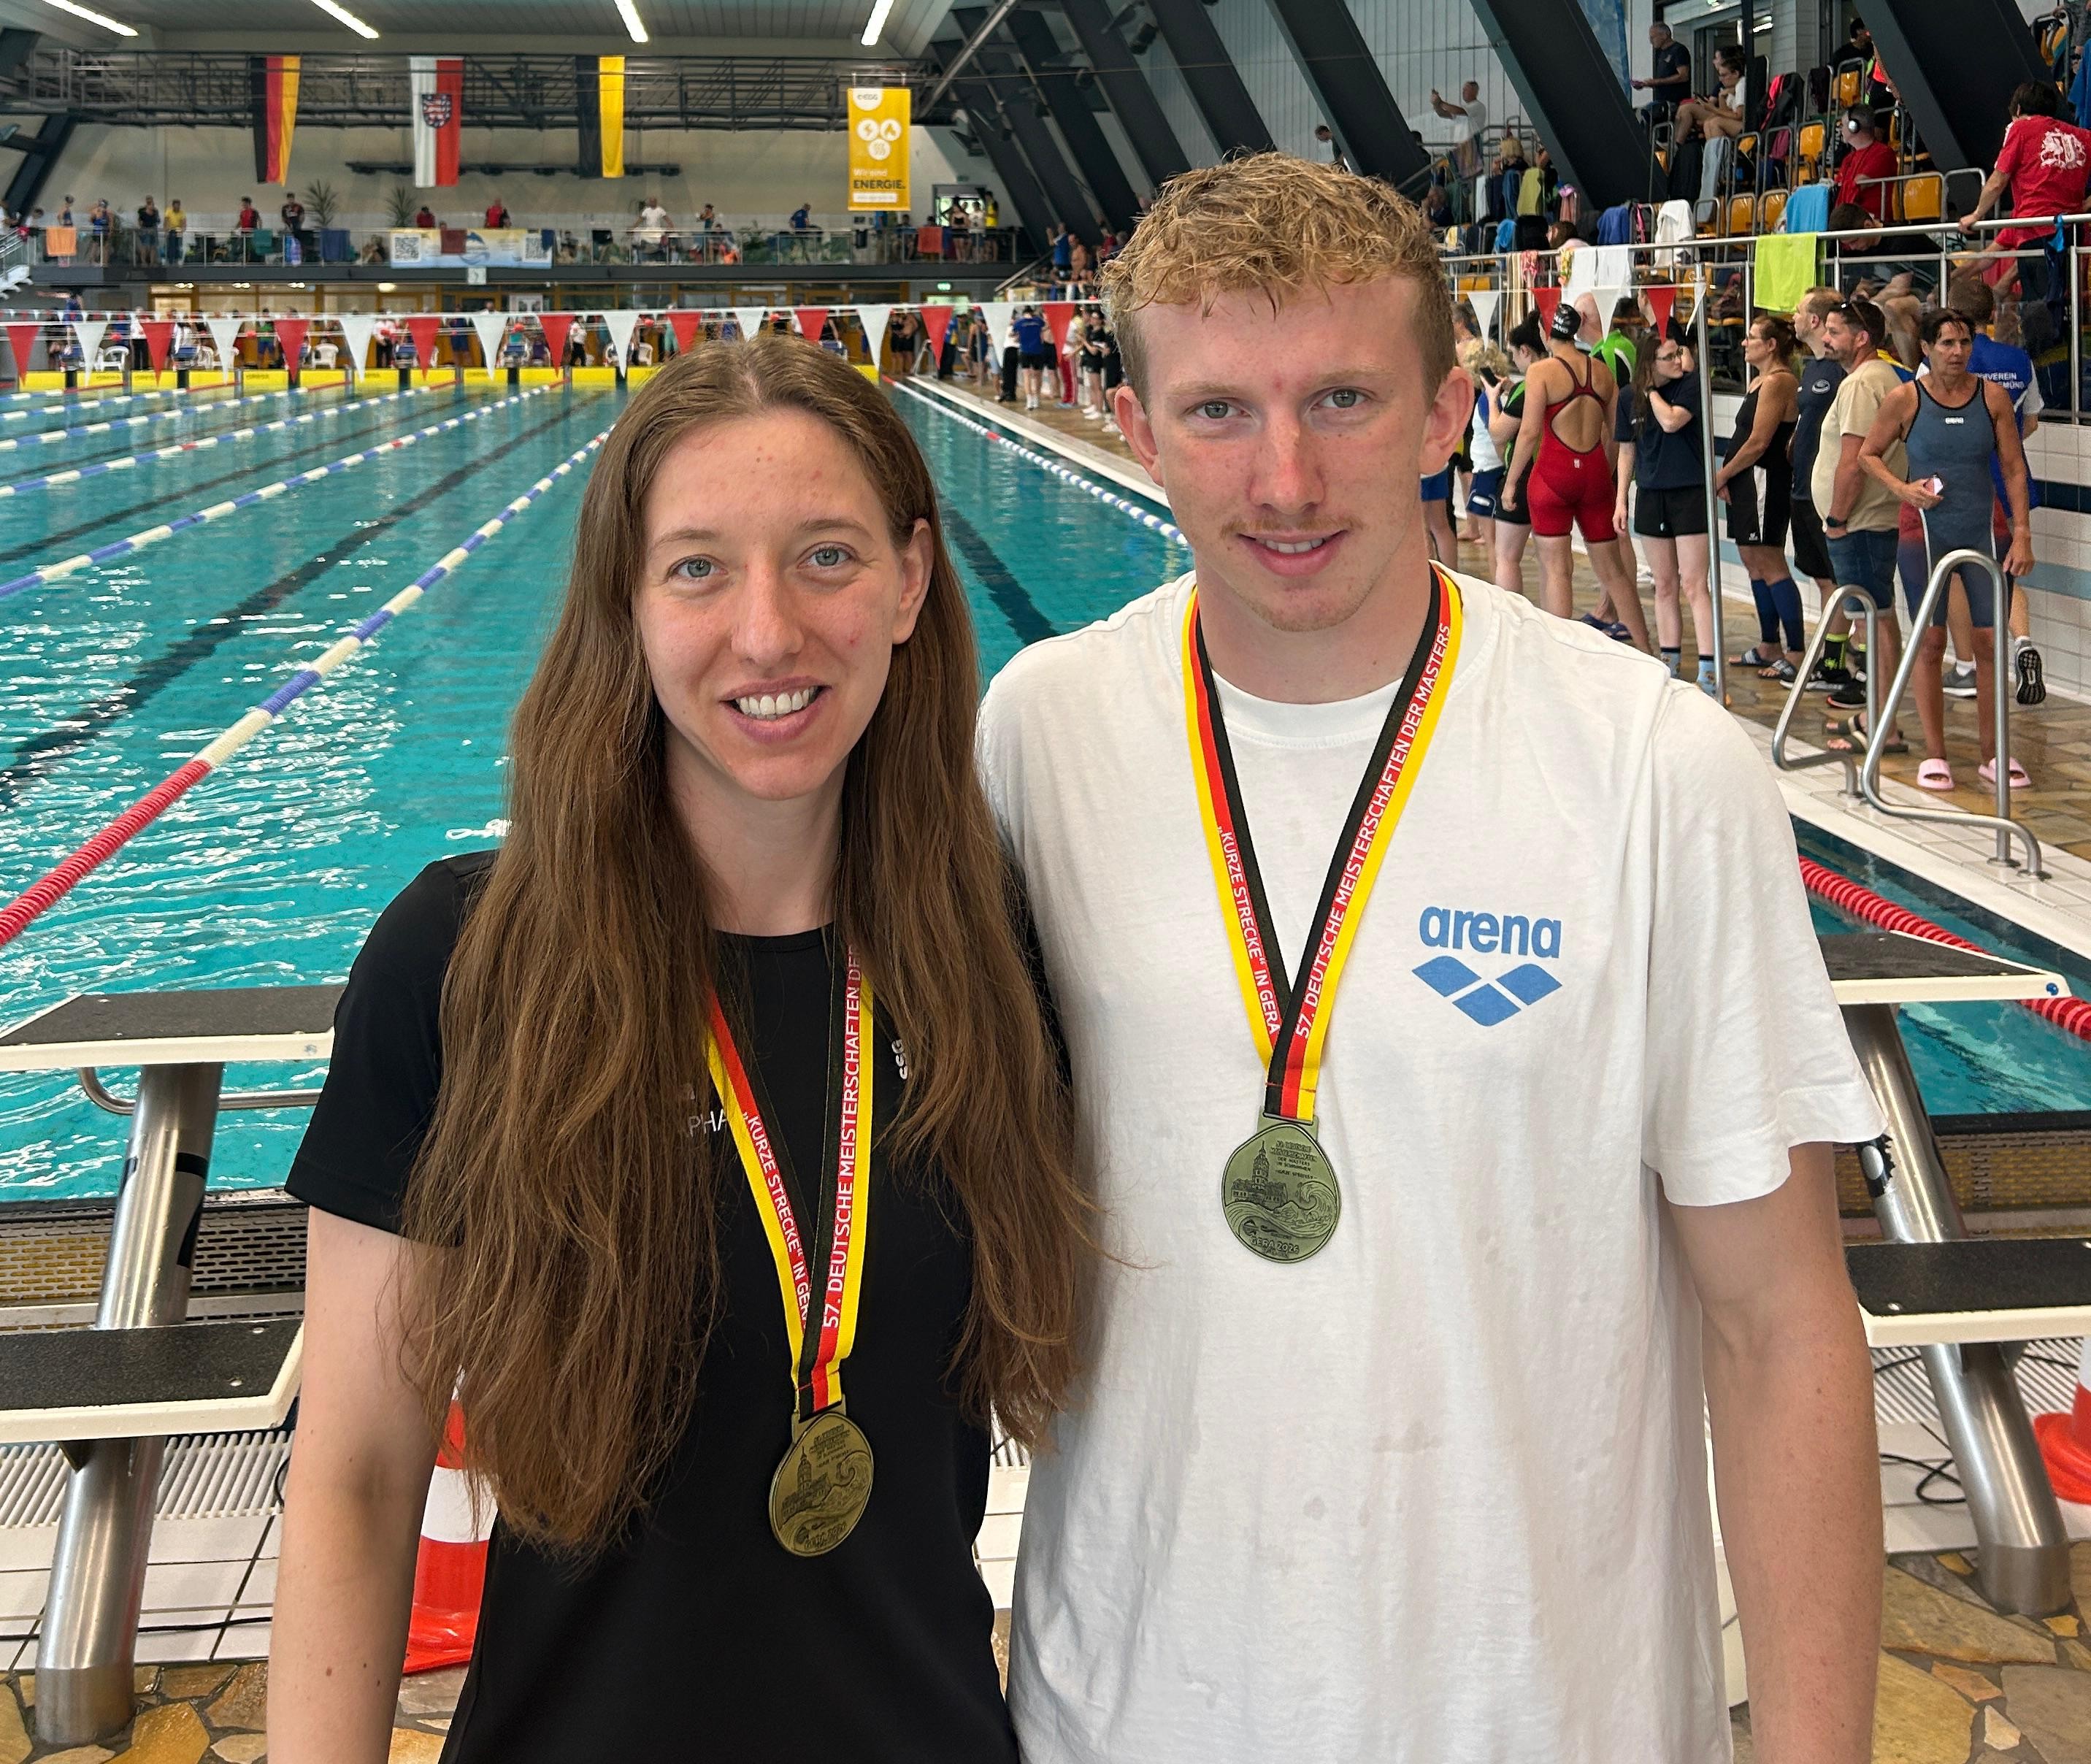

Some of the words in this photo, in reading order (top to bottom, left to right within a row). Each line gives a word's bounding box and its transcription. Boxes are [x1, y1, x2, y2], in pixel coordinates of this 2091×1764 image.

[853, 180, 906, 189] ENERGIE.
[1415, 623, 1450, 702] MASTERS
[1402, 702, 1424, 738] DER
[1335, 737, 1411, 906] MEISTERSCHAFTEN
[1419, 906, 1562, 959] arena
[1254, 970, 1270, 986] IN
[1305, 908, 1345, 1008] DEUTSCHE
[1259, 990, 1281, 1035] GERA
[1296, 1013, 1315, 1039] 57.
[840, 986, 860, 1178] MEISTERSCHAFTEN
[828, 1182, 853, 1292] DEUTSCHE
[793, 1261, 806, 1281] IN
[797, 1282, 810, 1328] GER
[823, 1299, 841, 1328] 57.
